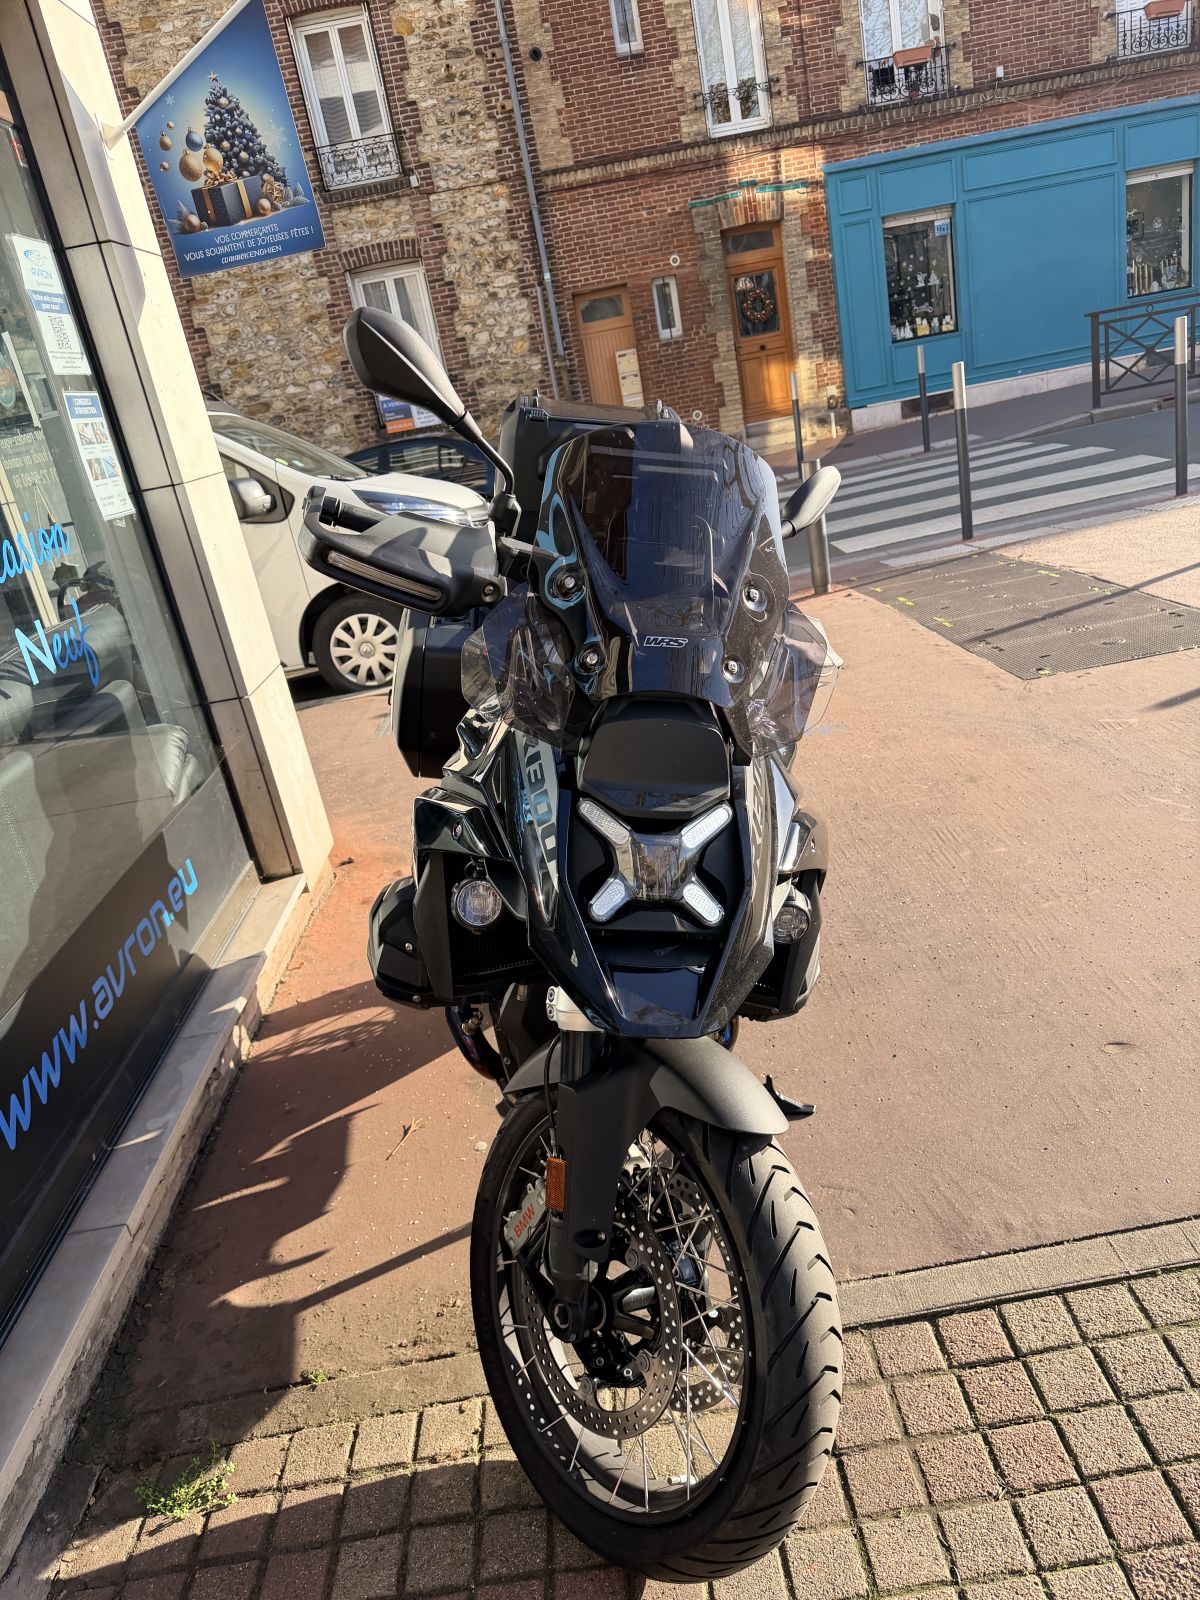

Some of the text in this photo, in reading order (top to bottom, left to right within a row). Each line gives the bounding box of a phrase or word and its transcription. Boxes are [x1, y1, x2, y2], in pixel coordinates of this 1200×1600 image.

[184, 250, 205, 262] VOUS
[205, 240, 246, 257] SOUHAITENT
[247, 239, 257, 249] DE
[257, 231, 290, 247] JOYEUSES
[290, 227, 310, 239] FÊTES
[214, 223, 279, 245] VOS COMMERÇANTS
[15, 598, 99, 688] Neuf
[643, 635, 689, 648] WRS
[0, 858, 198, 1151] www.avron.eu
[513, 1203, 536, 1239] BMW
